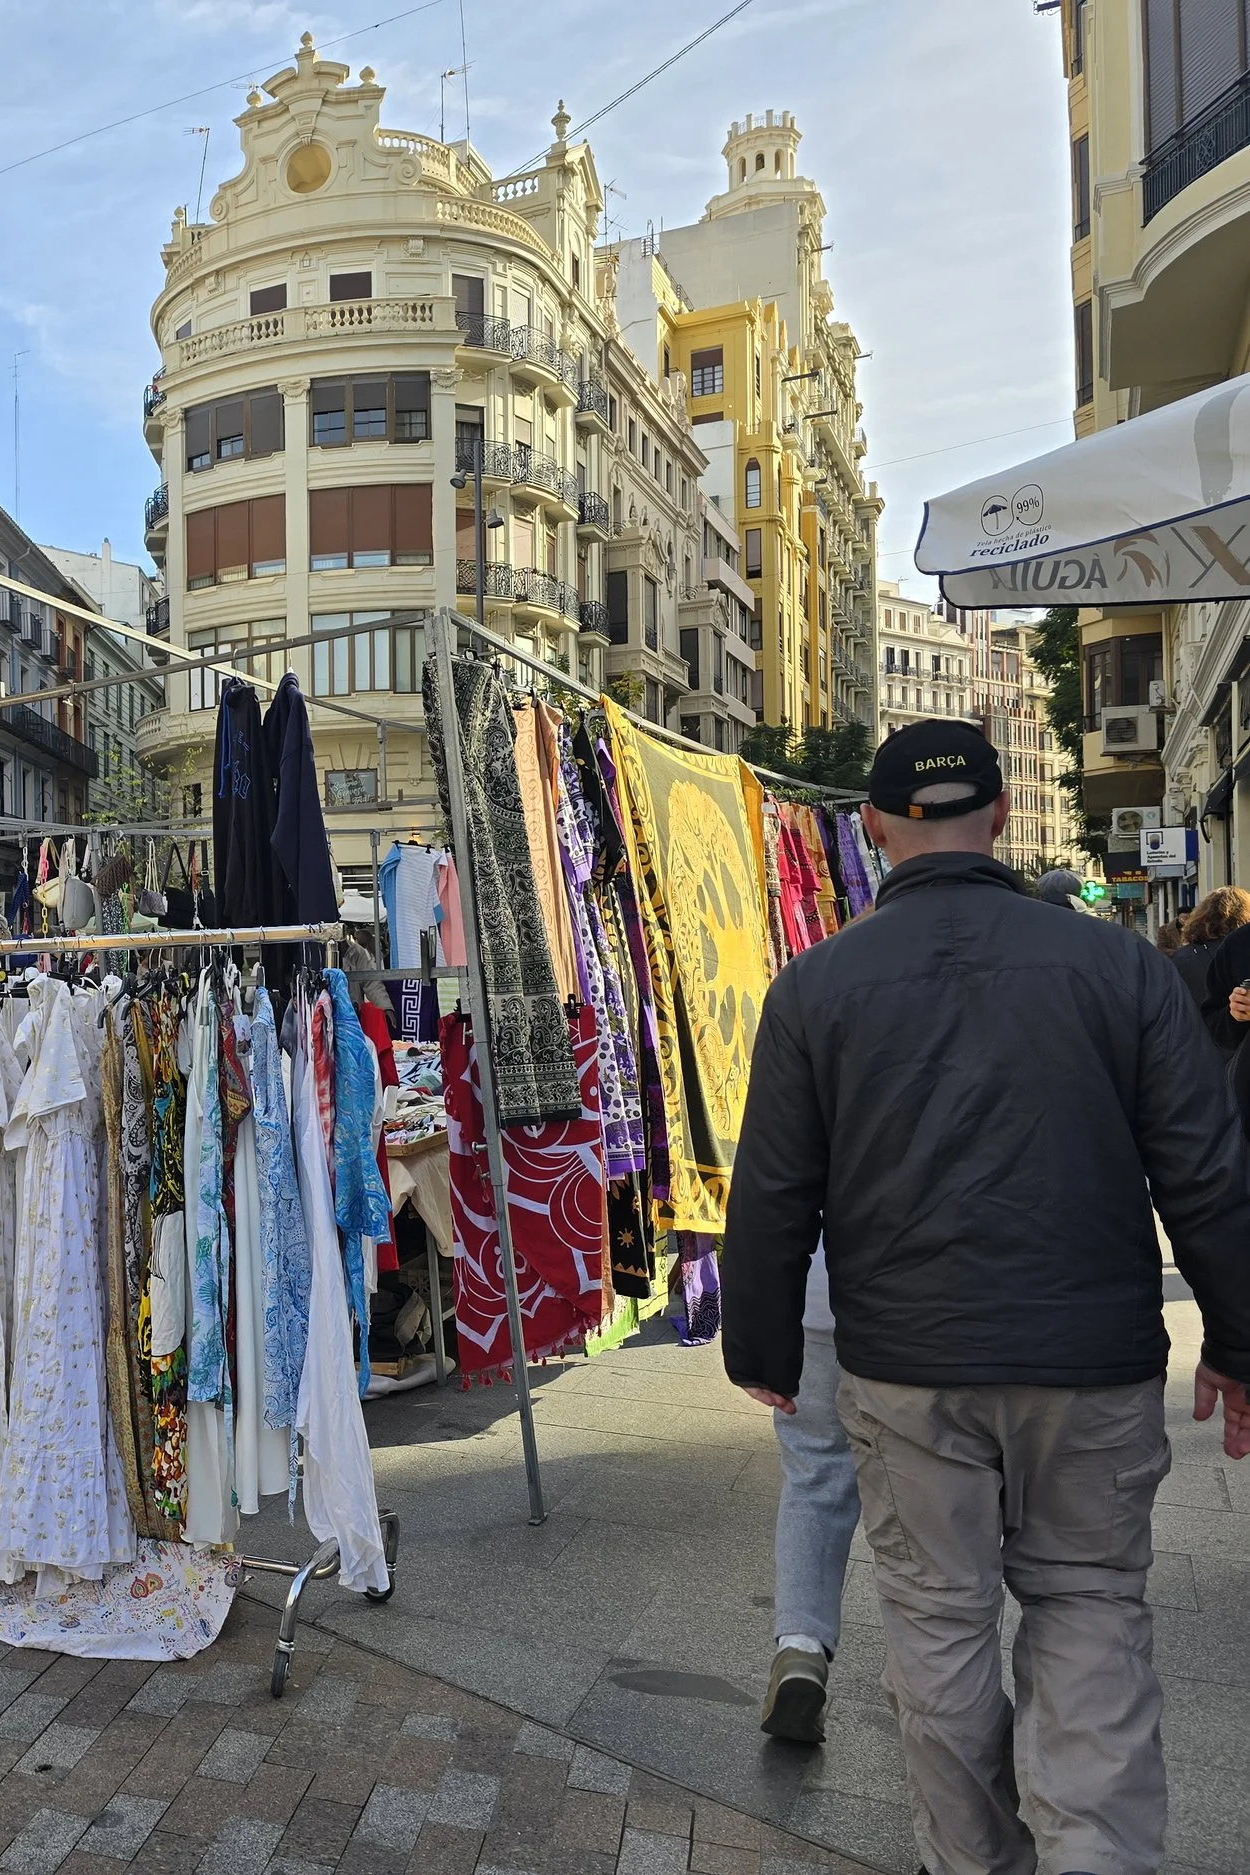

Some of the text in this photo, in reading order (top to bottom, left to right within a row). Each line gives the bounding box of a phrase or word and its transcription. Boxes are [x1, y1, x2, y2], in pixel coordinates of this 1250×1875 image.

[1016, 496, 1040, 514] 99%
[993, 534, 1014, 544] hecha
[1015, 531, 1023, 539] de
[1025, 523, 1052, 537] plástico
[970, 533, 1050, 557] reciclado
[914, 755, 967, 772] BARÇA
